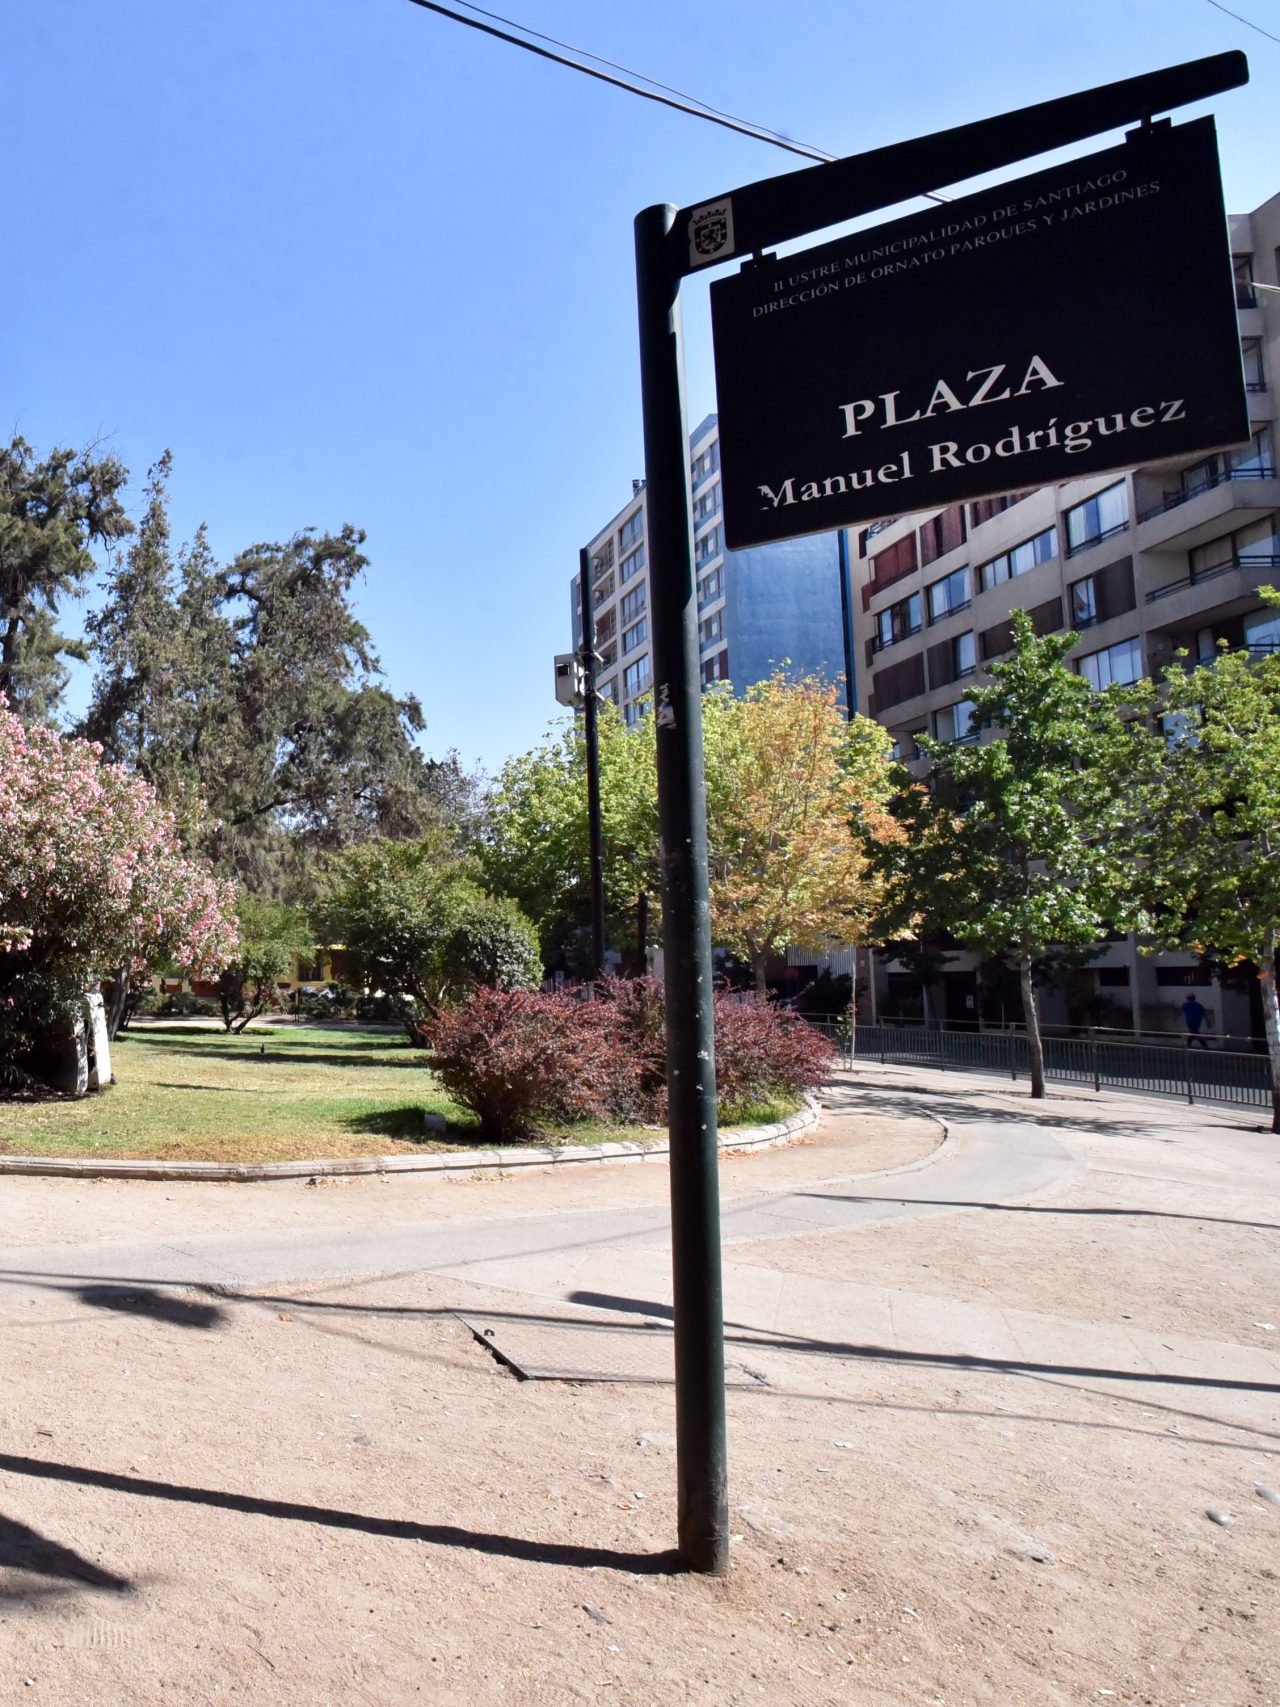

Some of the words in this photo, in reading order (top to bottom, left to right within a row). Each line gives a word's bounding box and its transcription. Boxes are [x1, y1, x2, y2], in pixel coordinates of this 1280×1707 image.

[752, 280, 840, 318] DIRECCIÓN
[844, 271, 867, 289] DE
[870, 247, 946, 279] ORNATO
[1042, 213, 1056, 226] Y
[1060, 180, 1161, 222] JARDINES
[844, 214, 987, 269] MUNICIPALIDAD
[992, 204, 1019, 222] DE
[1022, 169, 1128, 212] SANTIAGO
[838, 354, 1065, 439] PLAZA
[757, 450, 914, 510] Manuel
[927, 398, 1187, 473] Rodríguez
